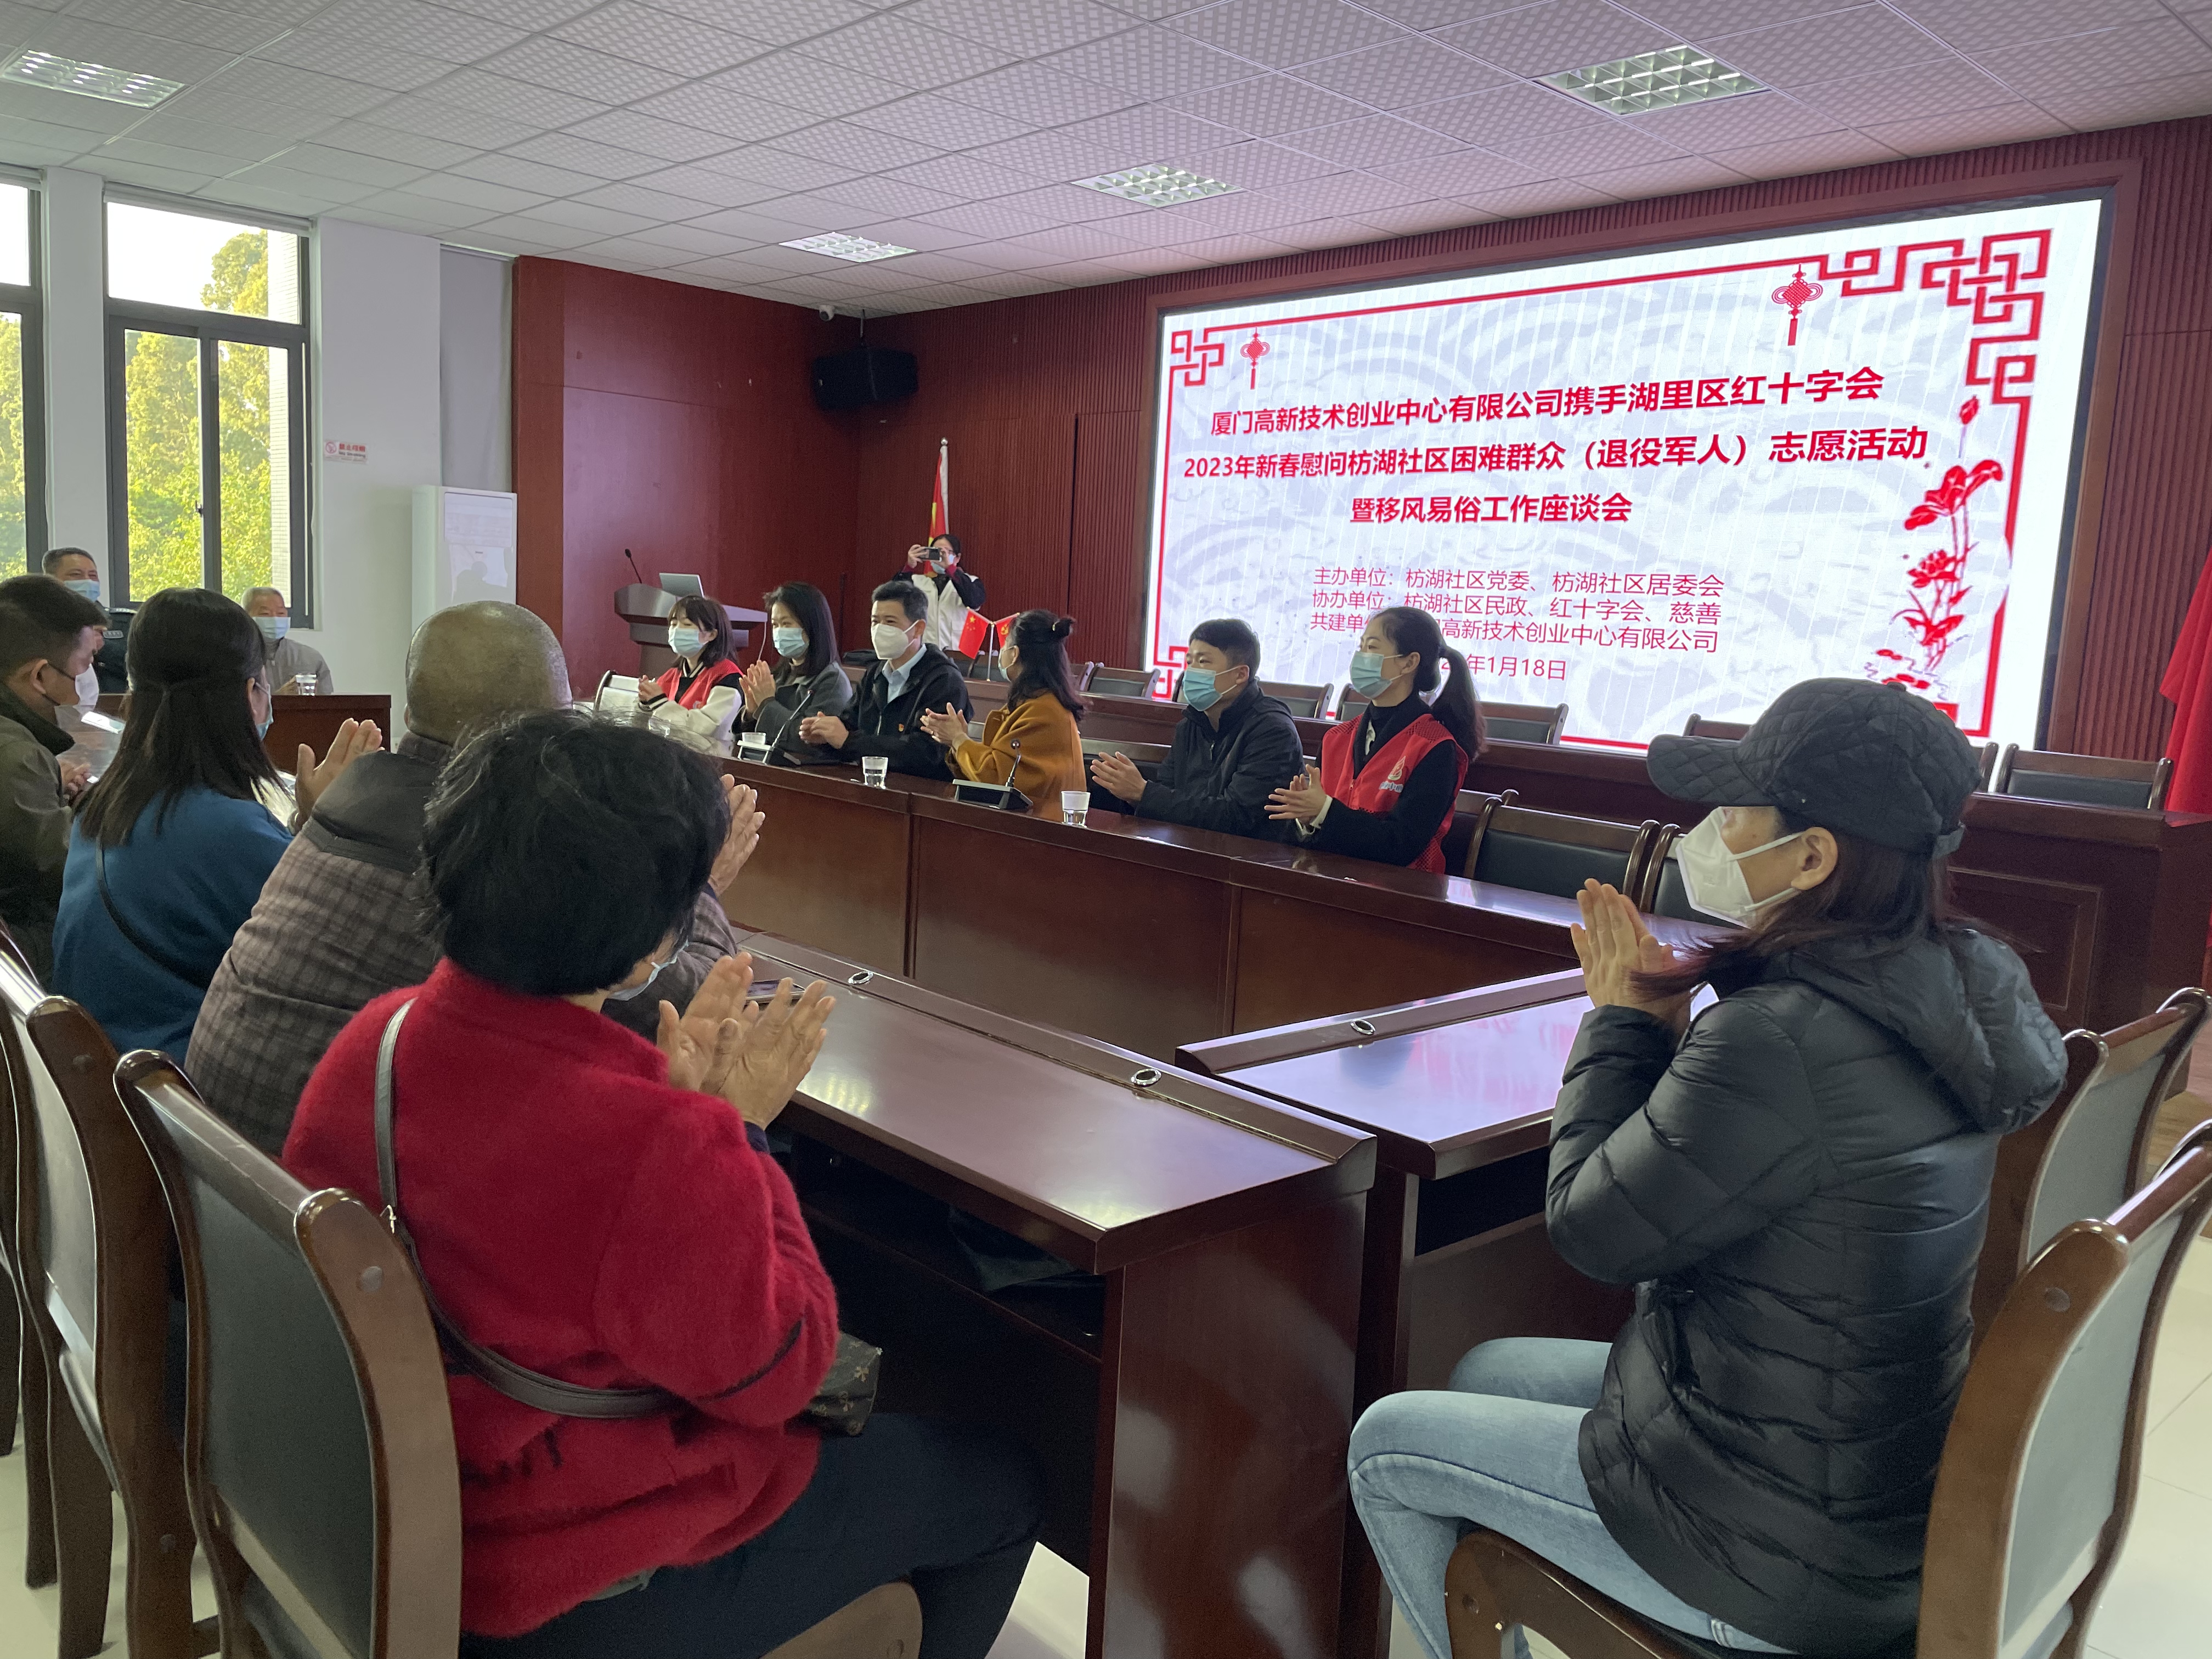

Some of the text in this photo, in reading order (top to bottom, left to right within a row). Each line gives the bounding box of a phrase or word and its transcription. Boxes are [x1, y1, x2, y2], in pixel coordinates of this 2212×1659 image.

[1210, 366, 1884, 436] 厦门高新技术创业中心有限公司携手湖里区红十字会
[1183, 425, 1928, 479] 2023年新春慰问枋湖社区困难群众（退役军人）志愿活动
[1350, 492, 1633, 524] 暨移风易俗工作座谈会
[1313, 566, 1725, 597] 主办单位：枋湖社区党委、枋湖社区居委会
[1310, 612, 1718, 653] 共建单高新技术创业中心有限公司
